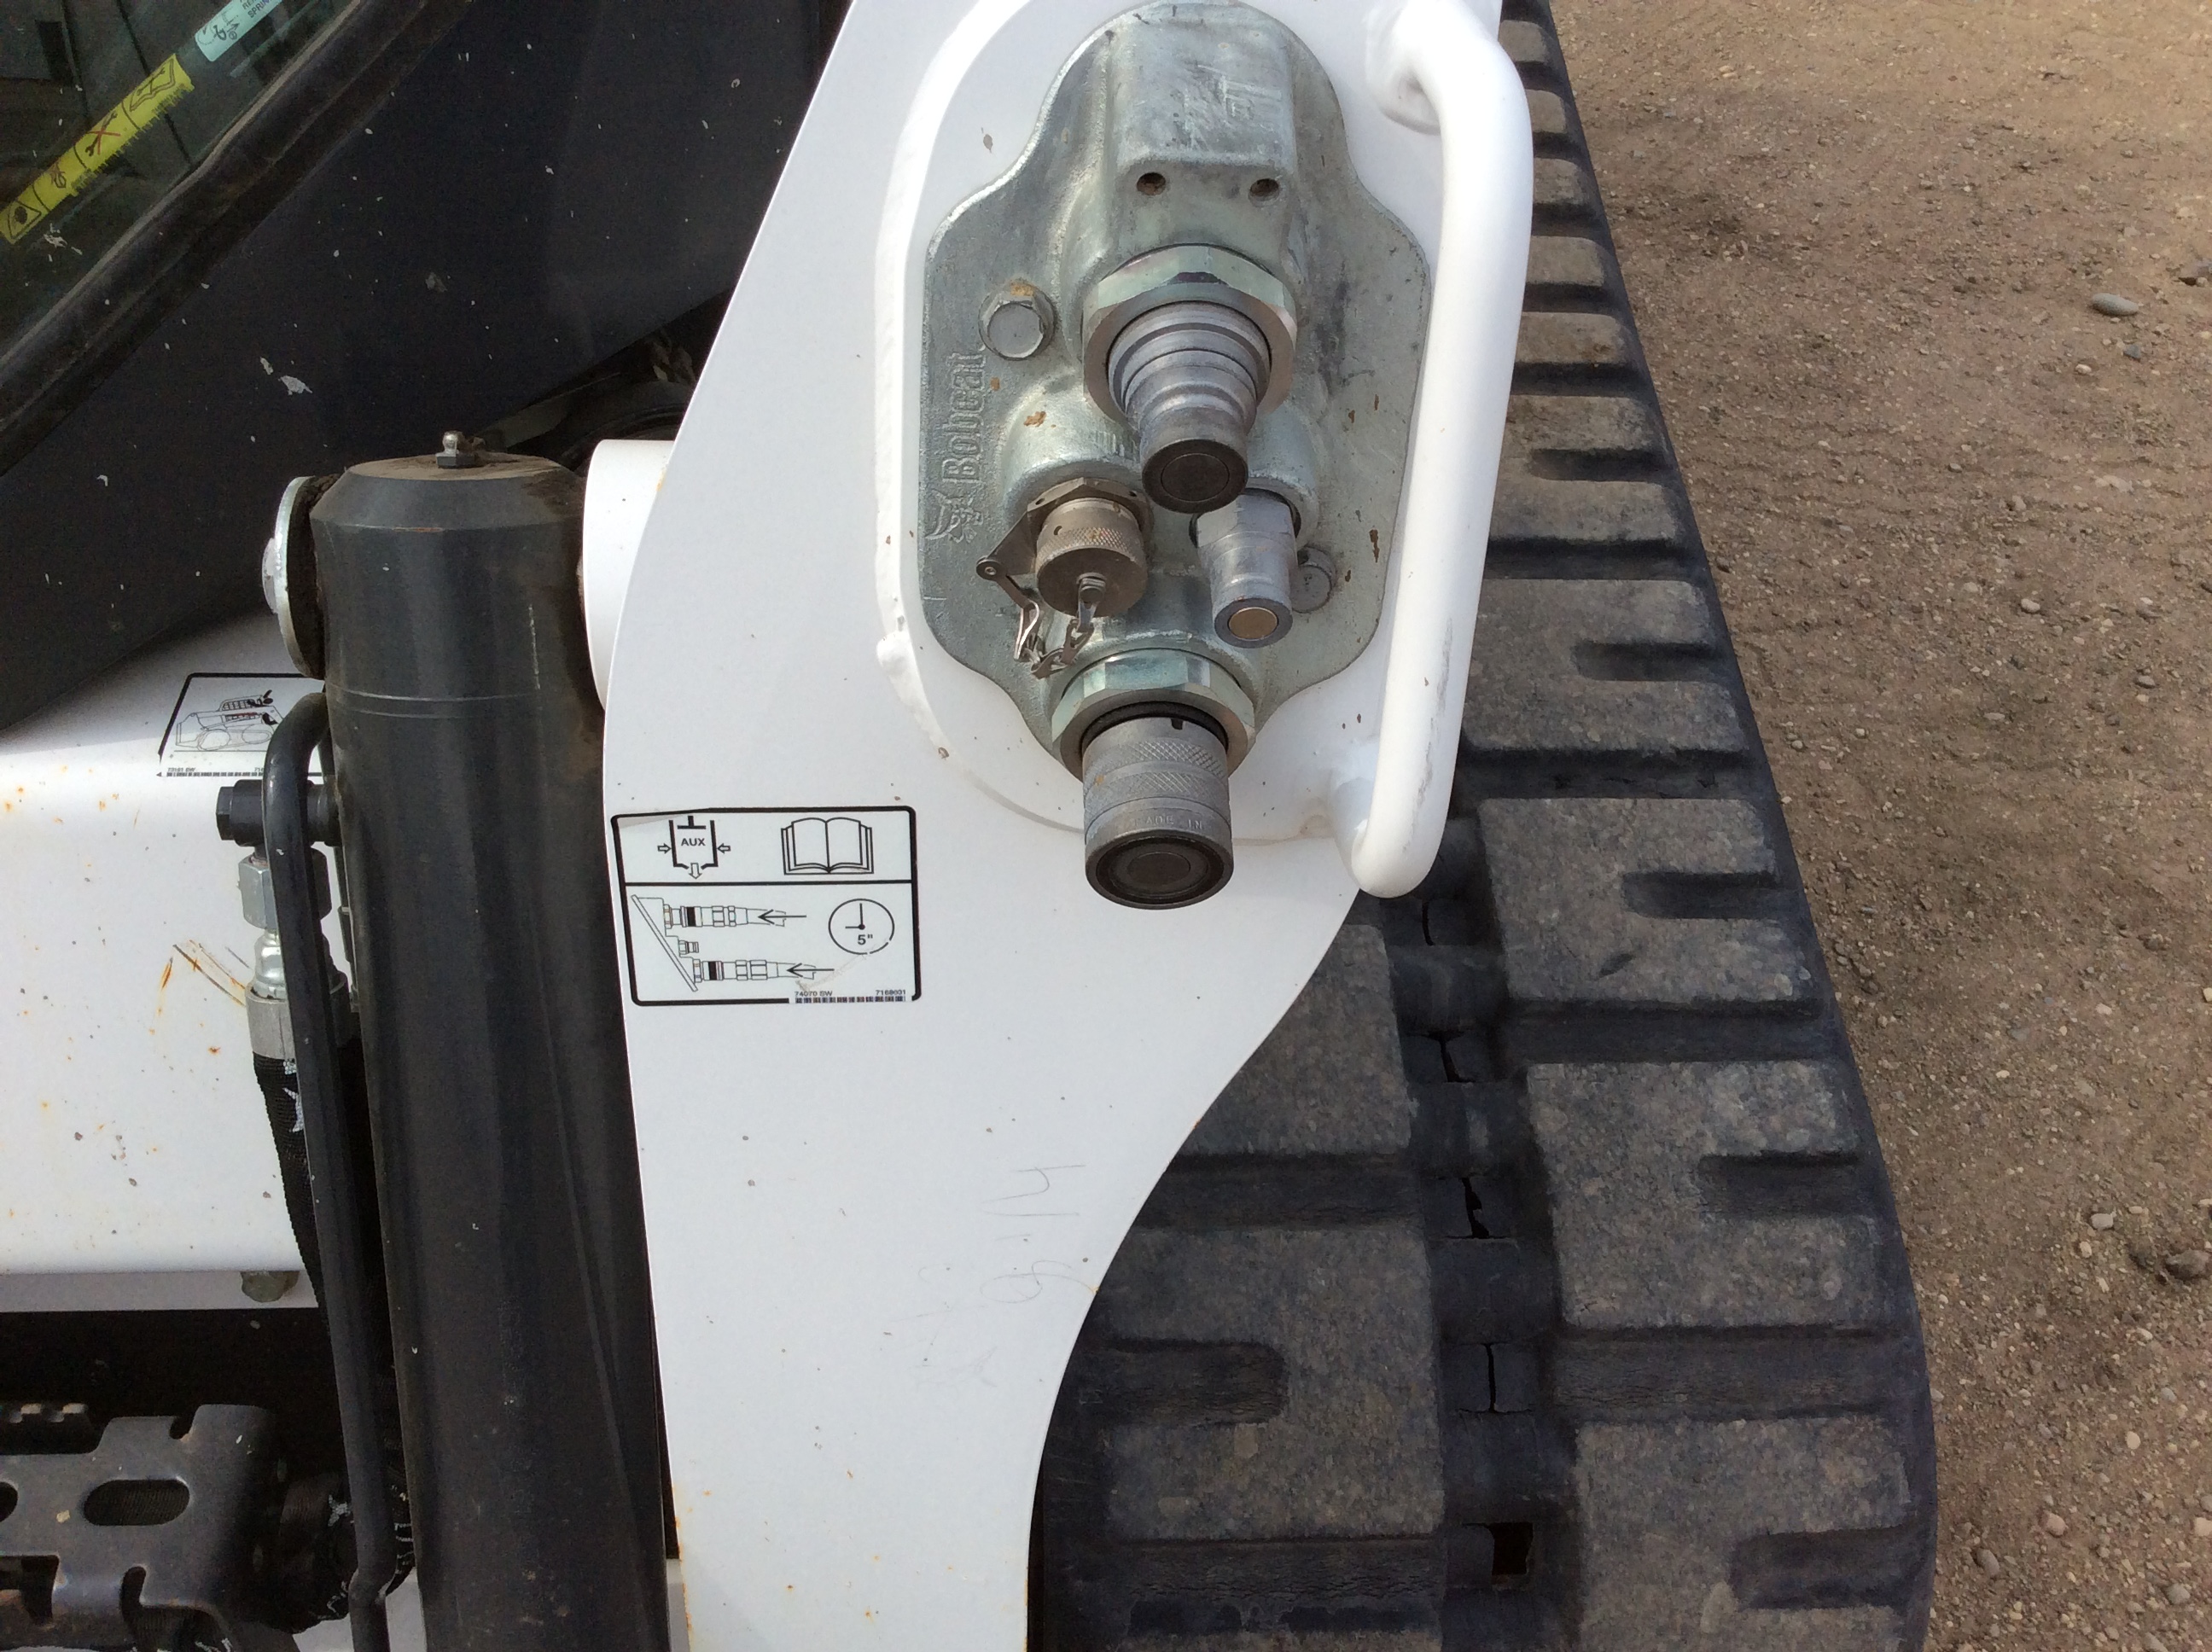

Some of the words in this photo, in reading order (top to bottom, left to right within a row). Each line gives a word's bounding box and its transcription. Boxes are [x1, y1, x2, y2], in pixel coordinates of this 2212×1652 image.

[247, 0, 272, 18] SPRIN
[942, 352, 987, 482] Bobcat
[681, 837, 706, 846] AUX
